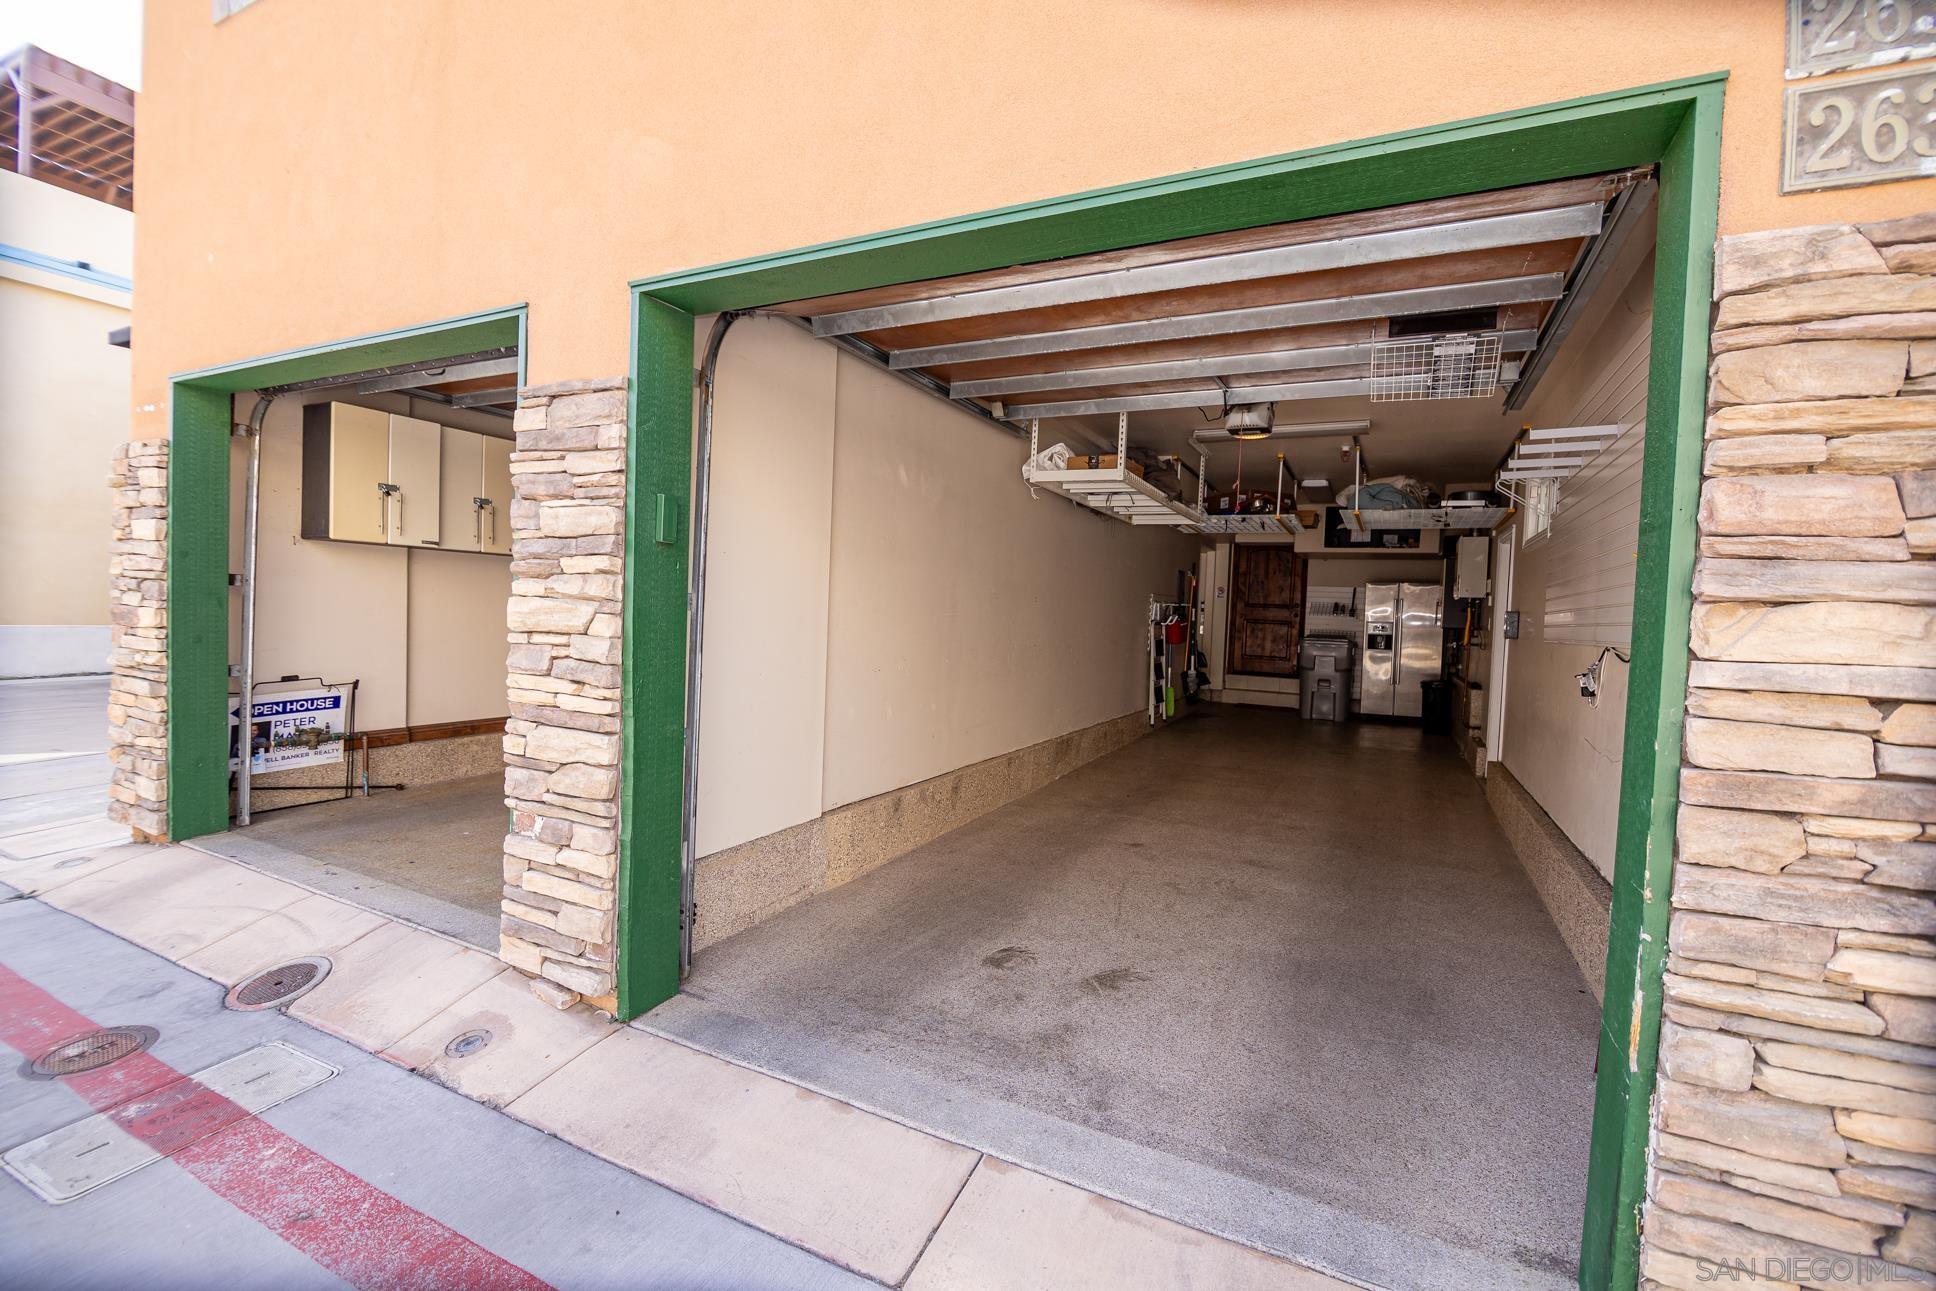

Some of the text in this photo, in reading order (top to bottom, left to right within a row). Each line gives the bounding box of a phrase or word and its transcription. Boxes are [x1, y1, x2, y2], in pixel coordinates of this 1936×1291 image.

[1810, 0, 1936, 57] 26
[252, 698, 334, 716] PEN HOUSE
[273, 716, 316, 729] PETER
[281, 752, 310, 760] BANKER
[313, 748, 340, 756] REALTY
